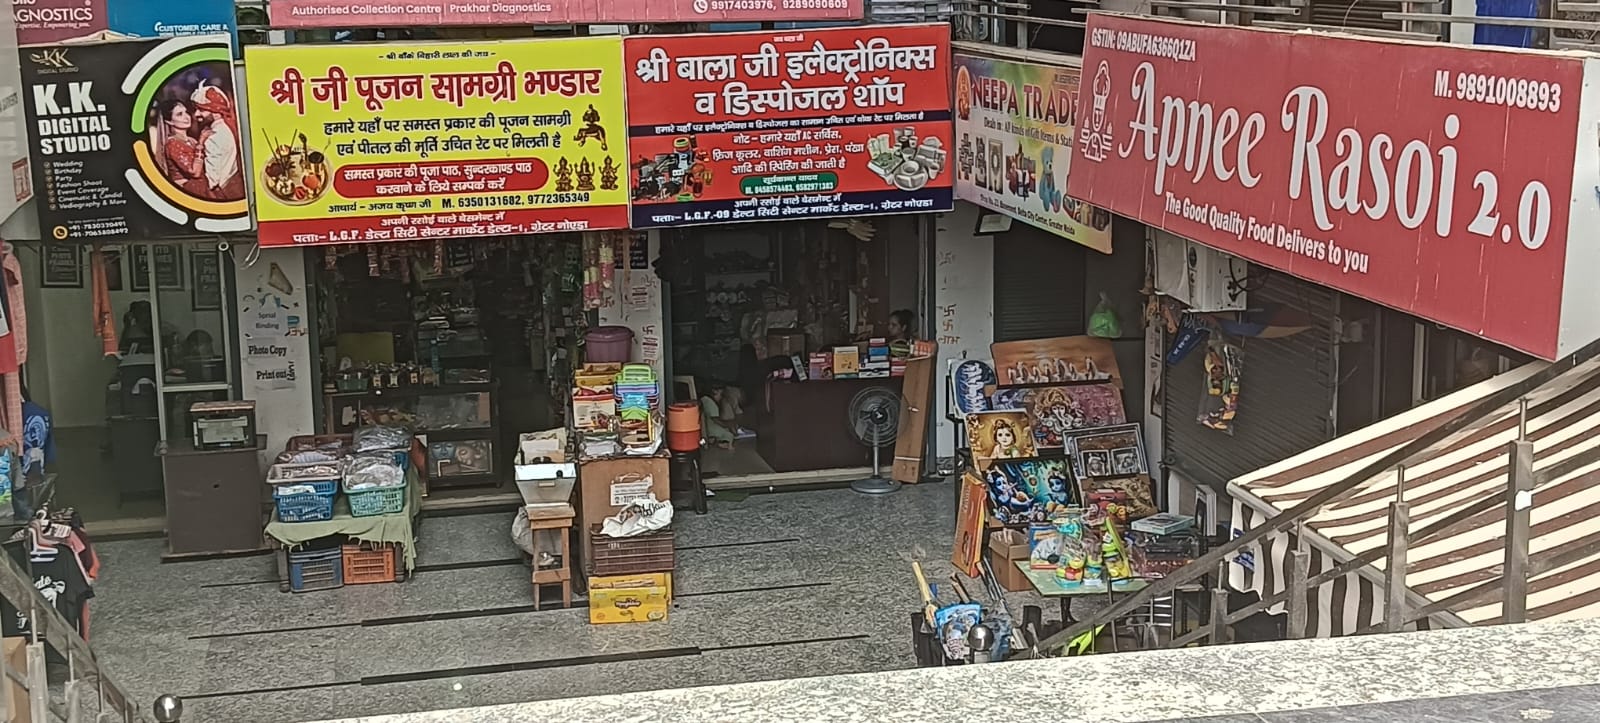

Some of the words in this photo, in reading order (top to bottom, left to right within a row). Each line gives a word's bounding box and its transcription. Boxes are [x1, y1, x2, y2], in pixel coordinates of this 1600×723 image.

[292, 5, 349, 16] Authorised
[351, 4, 404, 15] Collection
[406, 4, 441, 14] Centre
[450, 3, 490, 13] Prakhar
[492, 3, 551, 14] Diagnostics
[711, 1, 776, 11] 9917403976,
[159, 24, 199, 32] CUSTOMER
[1091, 28, 1116, 51] GSTIN:
[635, 47, 669, 83] श्री
[676, 53, 736, 81] बाला
[742, 42, 780, 77] जी
[32, 81, 106, 116] K.K.
[269, 66, 305, 115] श्री
[311, 65, 348, 111] जी
[355, 73, 424, 111] पूजन
[431, 60, 517, 107] सामग्री
[524, 67, 603, 97] भण्डार
[695, 91, 716, 115] व
[722, 81, 847, 116] डिस्पोजल
[853, 75, 906, 107] शॉप
[970, 75, 1019, 116] NEEPA
[1434, 69, 1452, 99] M.
[1456, 76, 1562, 114] 9891008893
[38, 116, 111, 136] DIGITAL
[323, 118, 354, 135] हमारे
[358, 116, 381, 132] यहाँ
[384, 120, 400, 131] पर
[403, 118, 440, 131] समस्त
[443, 117, 476, 131] प्रकार
[479, 112, 495, 128] की
[498, 115, 529, 133] पूजन
[532, 109, 571, 127] सामग्री
[40, 133, 111, 155] STUDIO
[336, 139, 356, 155] एवं
[358, 138, 391, 155] पीतल
[395, 136, 411, 153] की
[415, 136, 438, 158] मूर्ति
[442, 135, 472, 151] उचित
[475, 135, 491, 150] रेट
[493, 138, 509, 149] पर
[512, 132, 549, 148] मिलती
[552, 130, 562, 148] है
[1118, 62, 1267, 195] Apnee
[1281, 85, 1460, 238] Rasoi
[1467, 170, 1552, 250] 2.0
[344, 168, 375, 180] समस्त
[376, 167, 402, 180] प्रकार
[404, 163, 418, 177] की
[420, 165, 440, 181] पूजा
[515, 162, 532, 173] पाठ
[376, 182, 412, 195] करवाने
[414, 181, 426, 193] के
[428, 179, 450, 192] लिये
[452, 177, 485, 191] सम्पर्क
[487, 176, 506, 190] करें
[442, 198, 455, 208] M.
[527, 192, 590, 205] 9772365349
[1164, 190, 1182, 217] The
[1182, 195, 1209, 226] Good
[1209, 205, 1246, 241] Quality
[1246, 216, 1275, 246] Food
[1276, 223, 1325, 261] Delivers
[1328, 238, 1342, 266] to
[1343, 246, 1370, 275] you
[248, 344, 269, 355] Photo
[269, 345, 287, 357] Copy
[256, 369, 275, 380] Print
